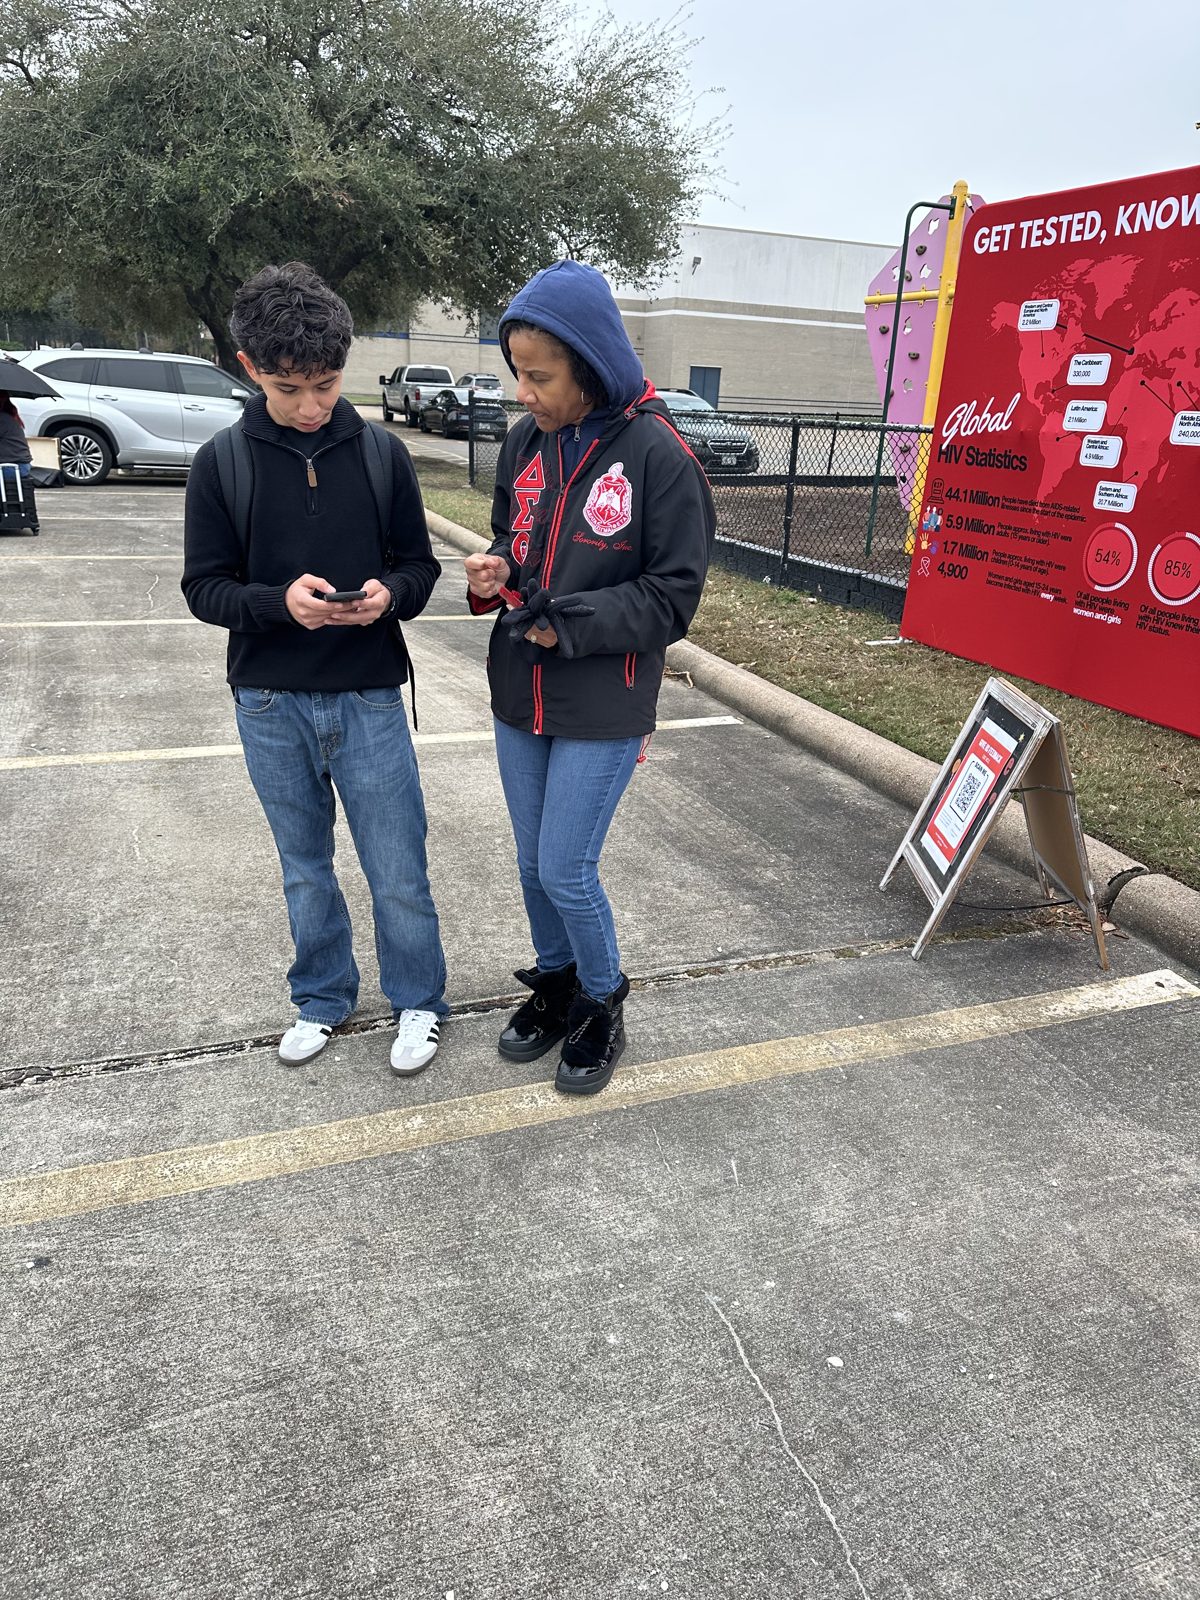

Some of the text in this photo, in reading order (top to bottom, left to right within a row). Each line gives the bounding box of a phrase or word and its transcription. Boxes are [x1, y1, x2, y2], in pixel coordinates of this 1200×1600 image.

[973, 192, 1200, 255] GET TESTED, KNOW
[942, 392, 1021, 450] Global
[937, 444, 1028, 472] HIV Statistics
[945, 487, 1000, 507] 44.1 Million
[1002, 496, 1016, 504] People
[1050, 503, 1080, 513] AIDS-related
[946, 514, 995, 535] 5.9 Million
[998, 522, 1012, 530] People
[1030, 528, 1040, 536] living
[943, 540, 989, 562] 1.7 Million
[992, 549, 1007, 558] People
[1024, 556, 1035, 566] living
[1046, 560, 1055, 568] HIV
[1095, 548, 1121, 566] 54%
[937, 561, 968, 579] 4,900
[991, 556, 1007, 566] children
[1164, 560, 1192, 579] 85%
[986, 578, 1004, 588] become
[1004, 582, 1022, 592] infected
[1022, 586, 1032, 594] with
[1041, 592, 1054, 602] every
[988, 571, 1004, 580] Women
[1013, 576, 1023, 586] girls
[1023, 580, 1035, 588] aged
[1036, 582, 1048, 591] 15-24
[1049, 586, 1062, 594] years
[1076, 591, 1083, 599] Of
[1090, 595, 1112, 605] people
[1112, 598, 1130, 611] living
[1086, 601, 1098, 610] HIV
[1073, 607, 1122, 624] women and girls
[1138, 614, 1152, 622] with
[1152, 616, 1165, 626] HIV
[1165, 618, 1185, 631] knew
[1140, 604, 1199, 626] Of all people living
[1136, 622, 1147, 631] HIV
